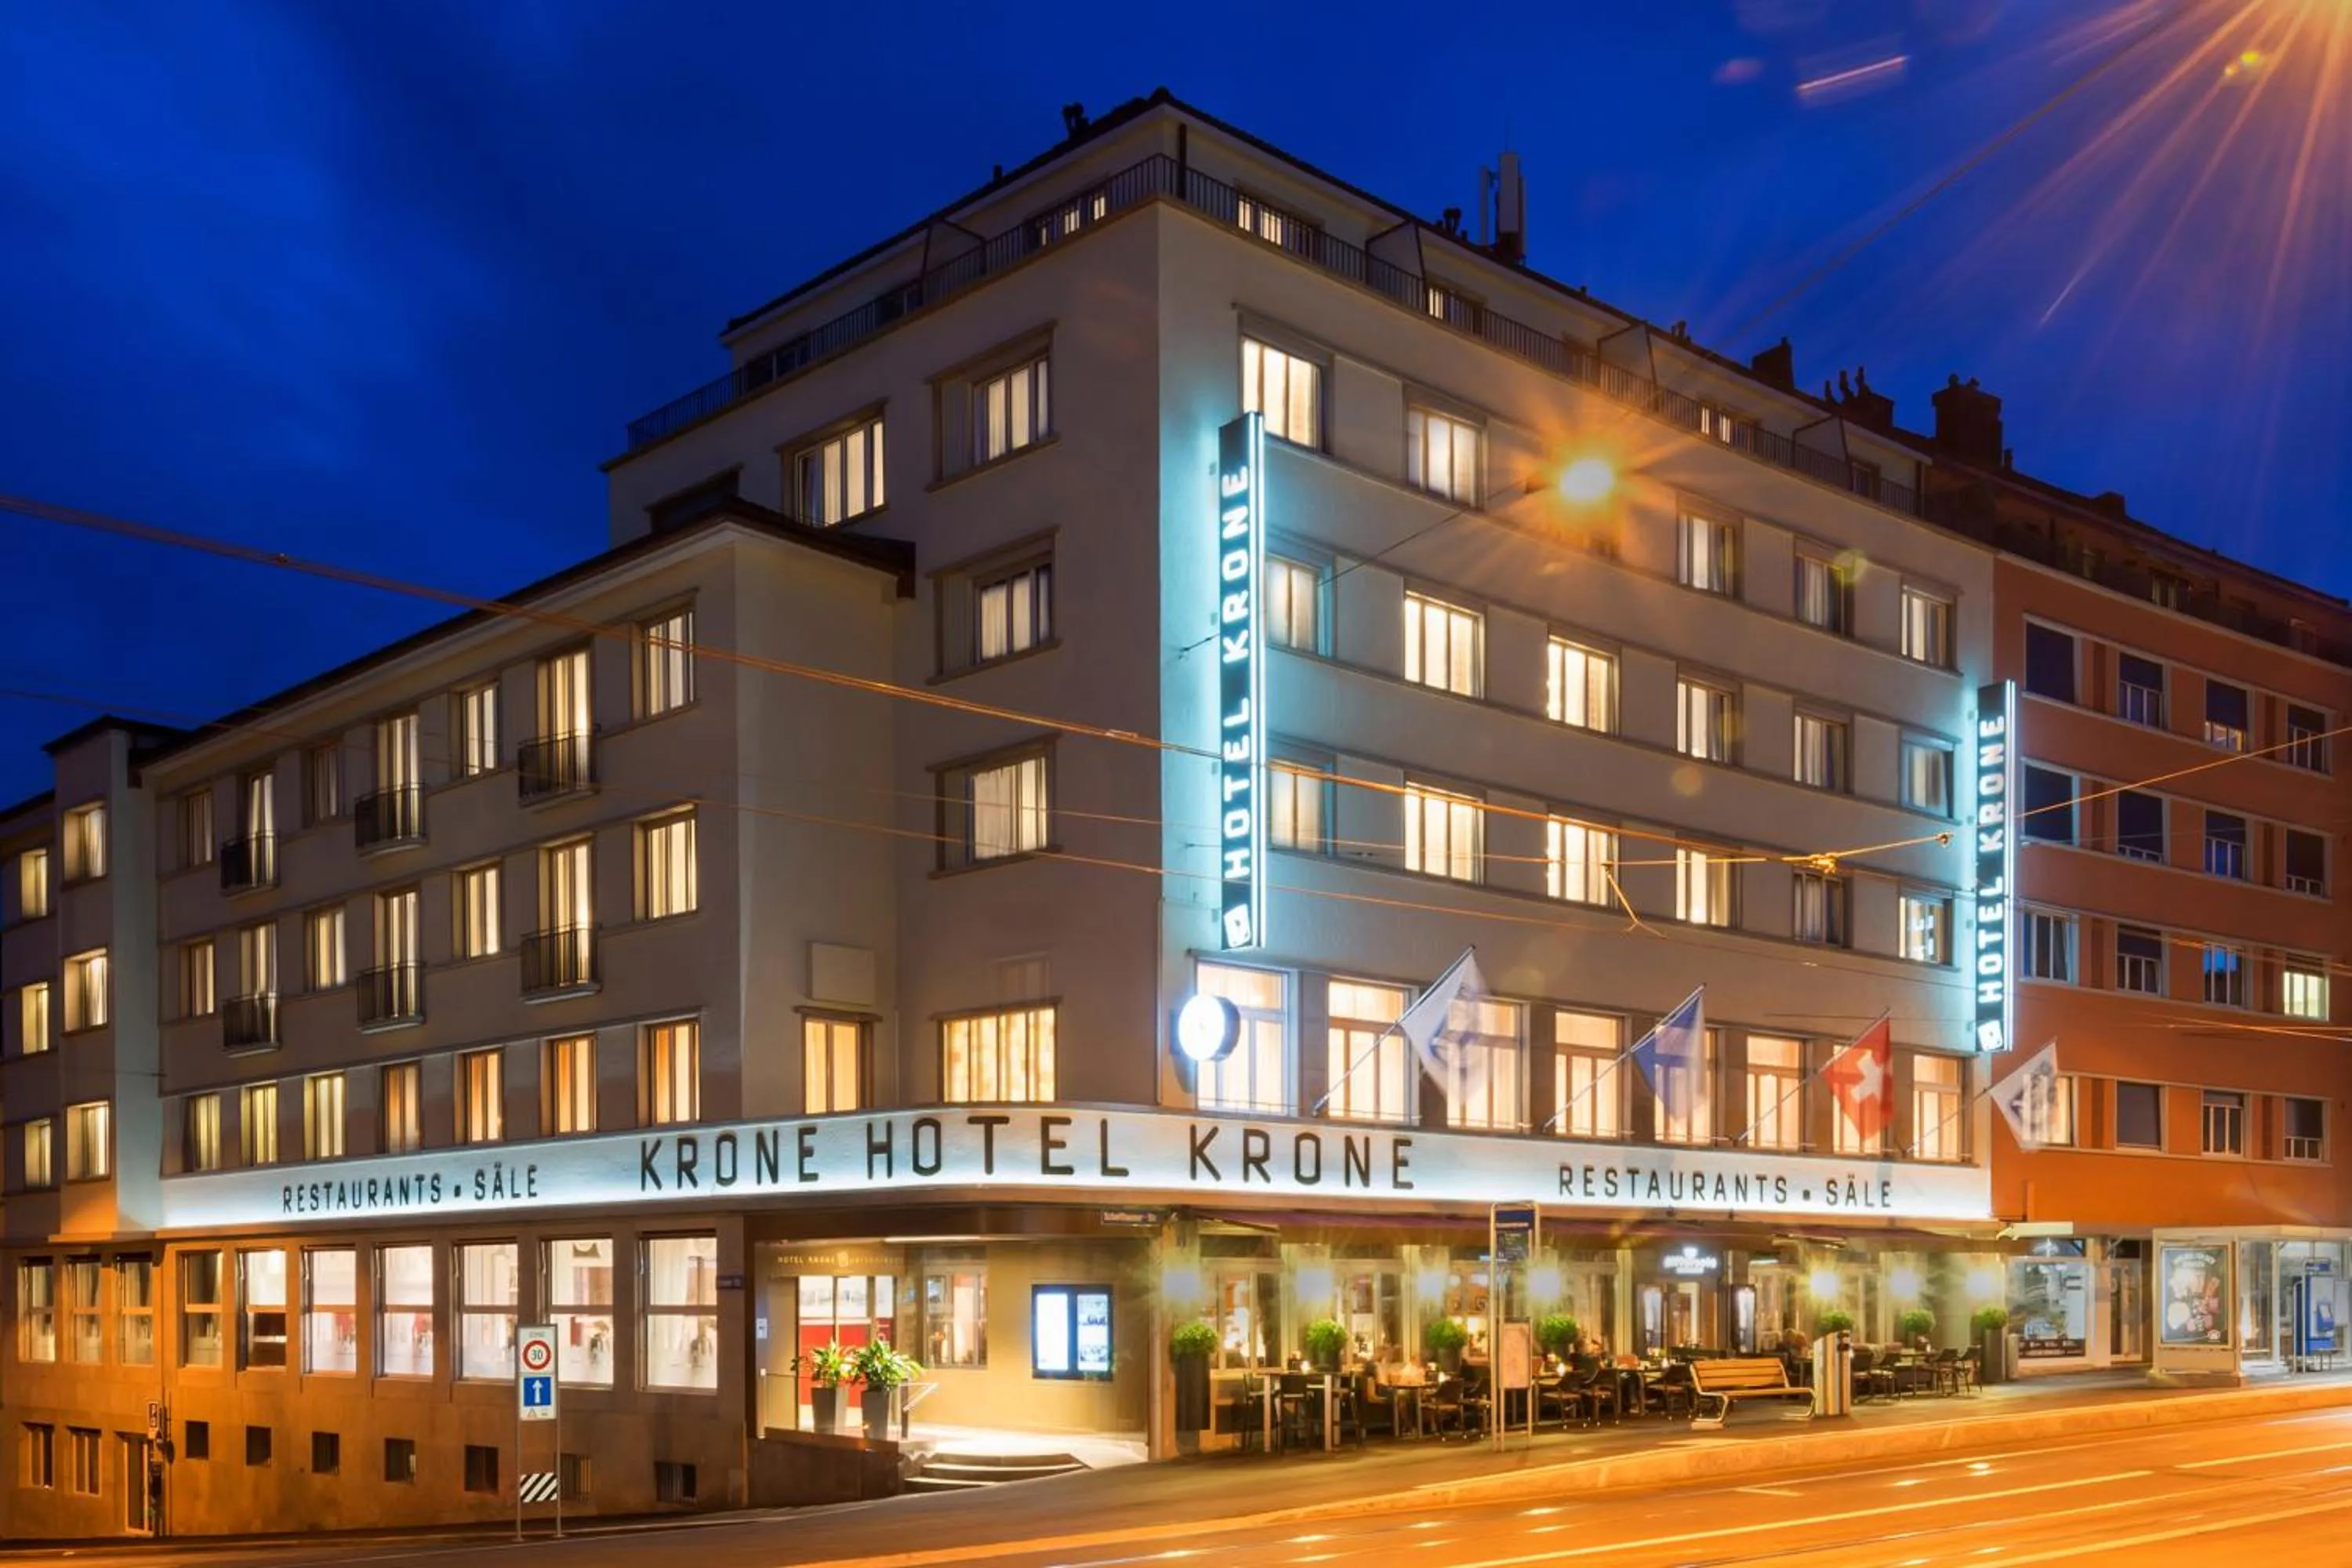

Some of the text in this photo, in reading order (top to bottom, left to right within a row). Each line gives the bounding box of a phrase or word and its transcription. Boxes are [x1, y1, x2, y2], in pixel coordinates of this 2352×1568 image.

[1221, 466, 1251, 880] HOTEL KRONE
[1977, 715, 2005, 1004] HOTEL KRONE
[641, 1116, 1415, 1192] KRONE HOTEL KRONE
[1559, 1164, 1893, 1208] RESTAURANTS SÄLE
[283, 1162, 539, 1214] RESTAURANTS SÄLE
[532, 1349, 543, 1361] 30
